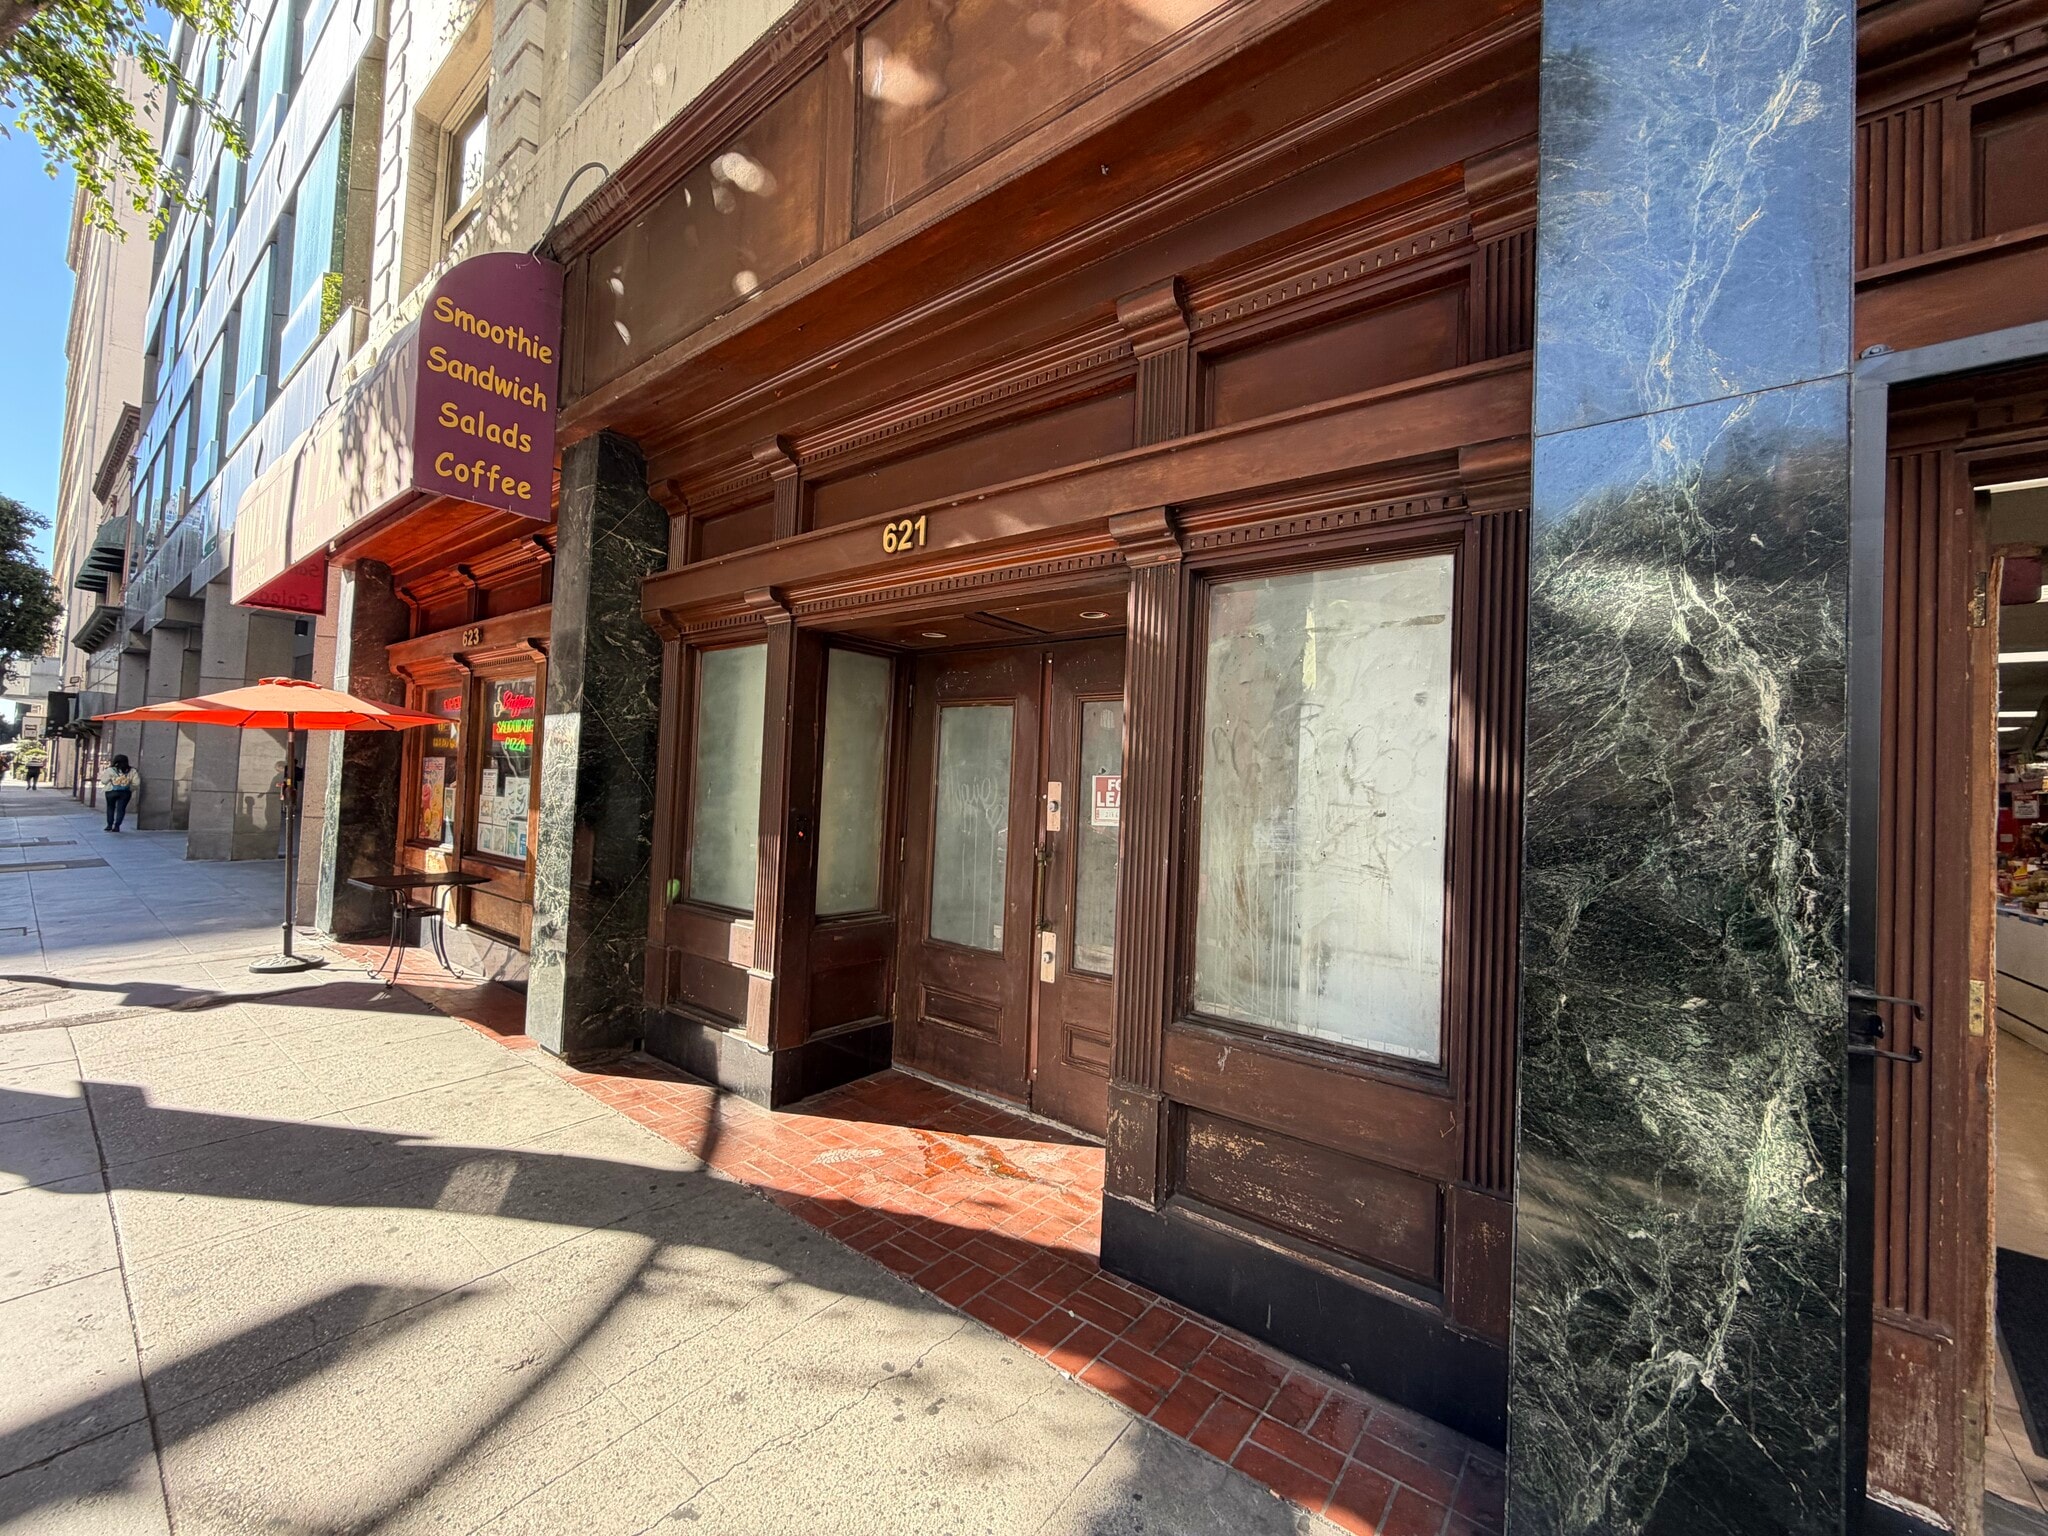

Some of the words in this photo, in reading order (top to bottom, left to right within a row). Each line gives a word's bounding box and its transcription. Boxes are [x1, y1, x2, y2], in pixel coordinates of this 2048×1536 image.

[433, 296, 552, 364] Smoothie
[427, 346, 547, 412] Sandwich
[438, 402, 531, 453] Salads
[435, 452, 532, 499] Coffee
[882, 515, 926, 553] 621
[462, 627, 480, 647] 623
[504, 737, 526, 752] PIZZA
[1107, 779, 1121, 791] FO
